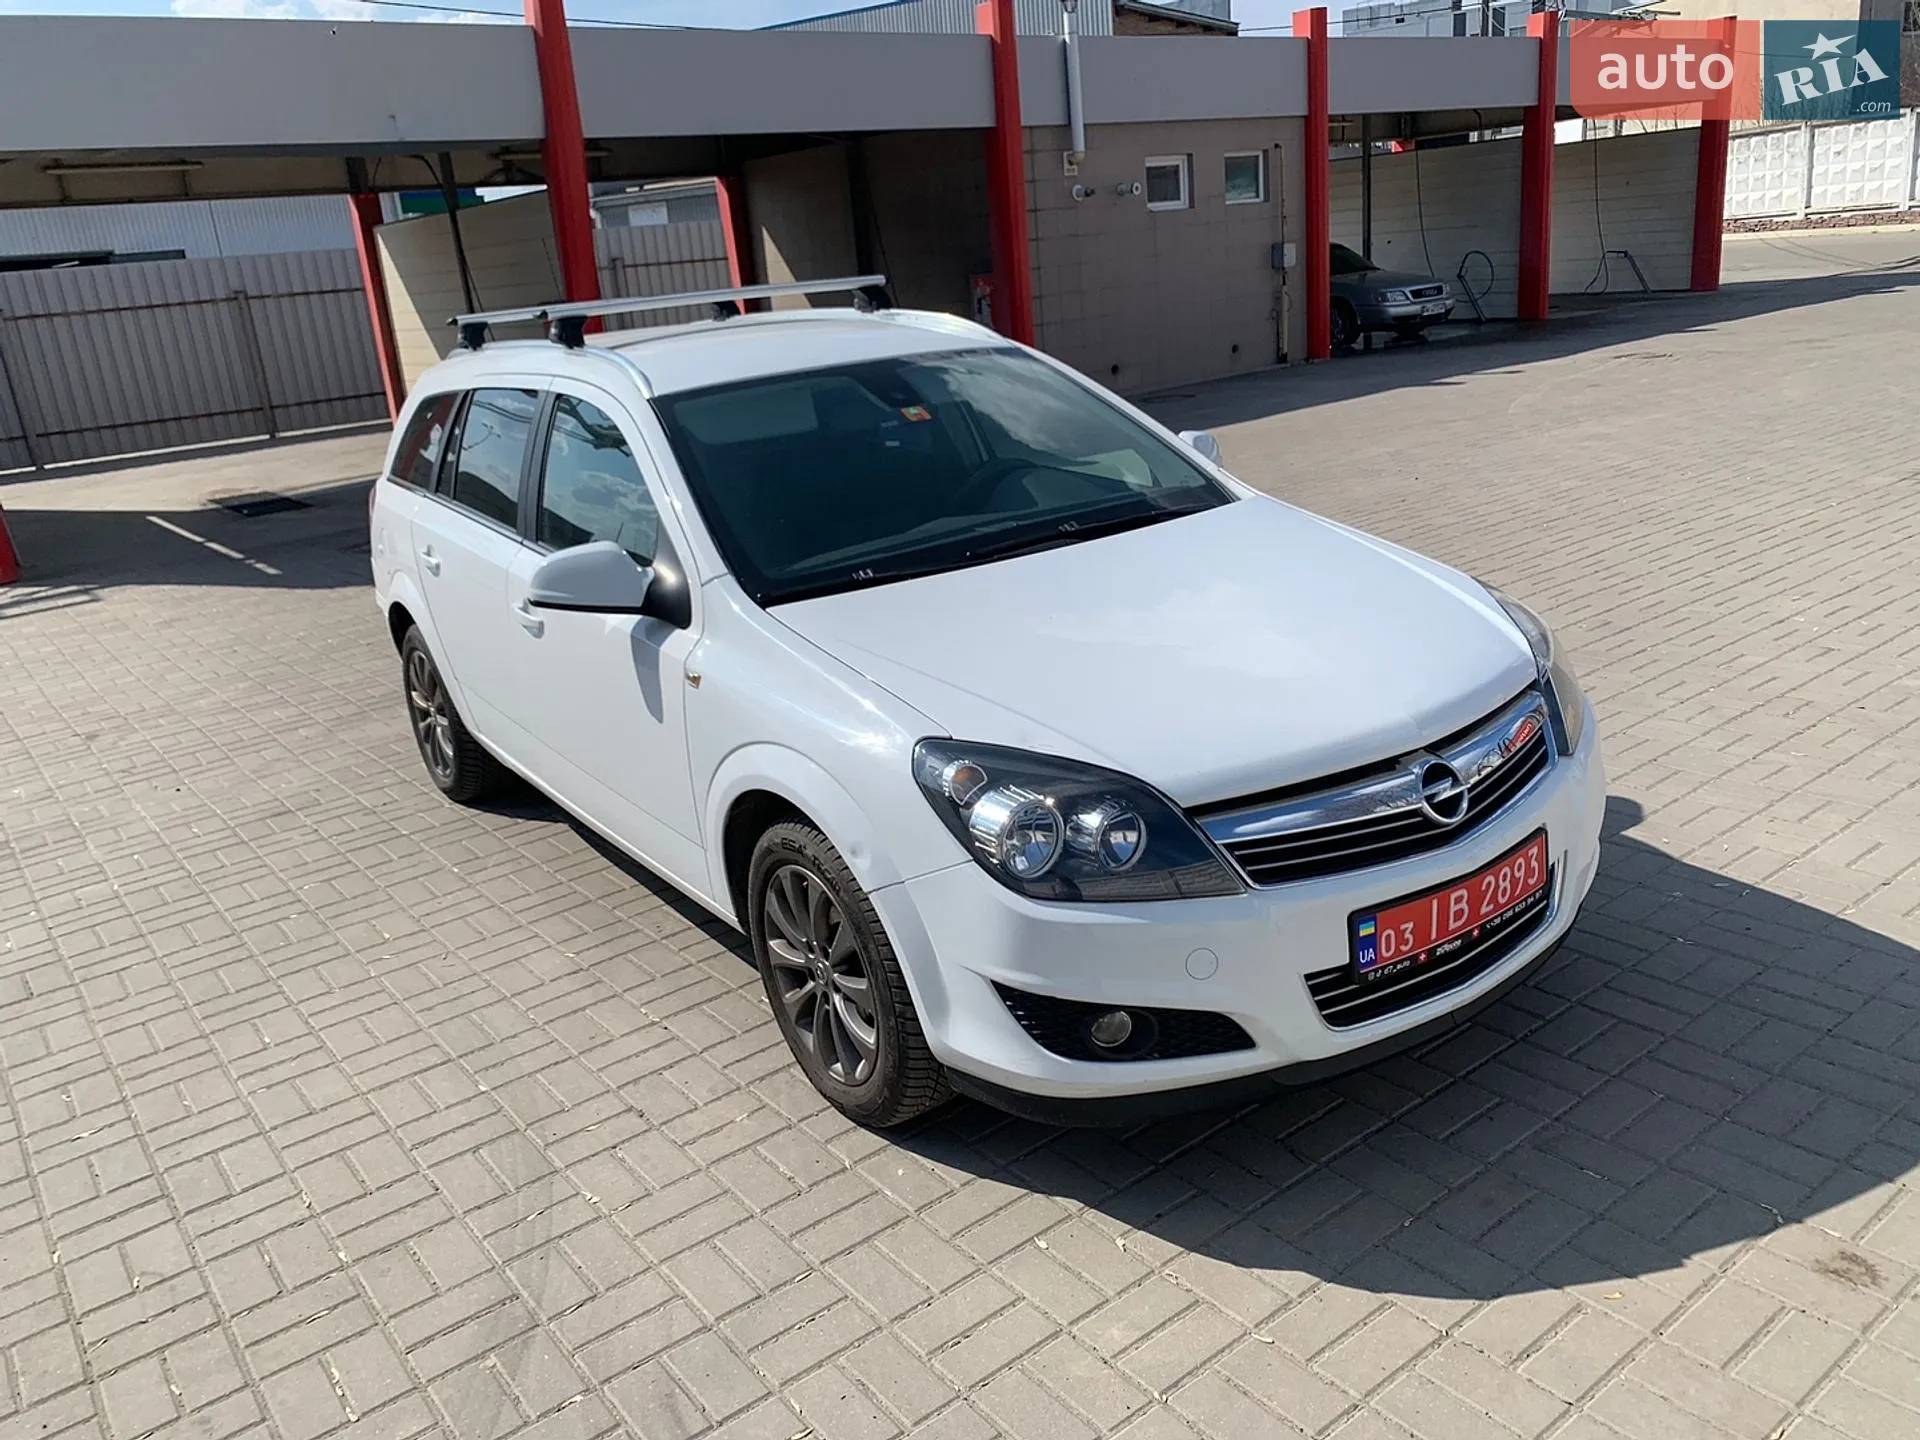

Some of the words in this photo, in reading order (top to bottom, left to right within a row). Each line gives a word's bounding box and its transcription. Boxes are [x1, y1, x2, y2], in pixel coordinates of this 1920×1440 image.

[1381, 921, 1415, 958] 03
[1479, 845, 1540, 916] 2893
[1359, 947, 1376, 964] UA
